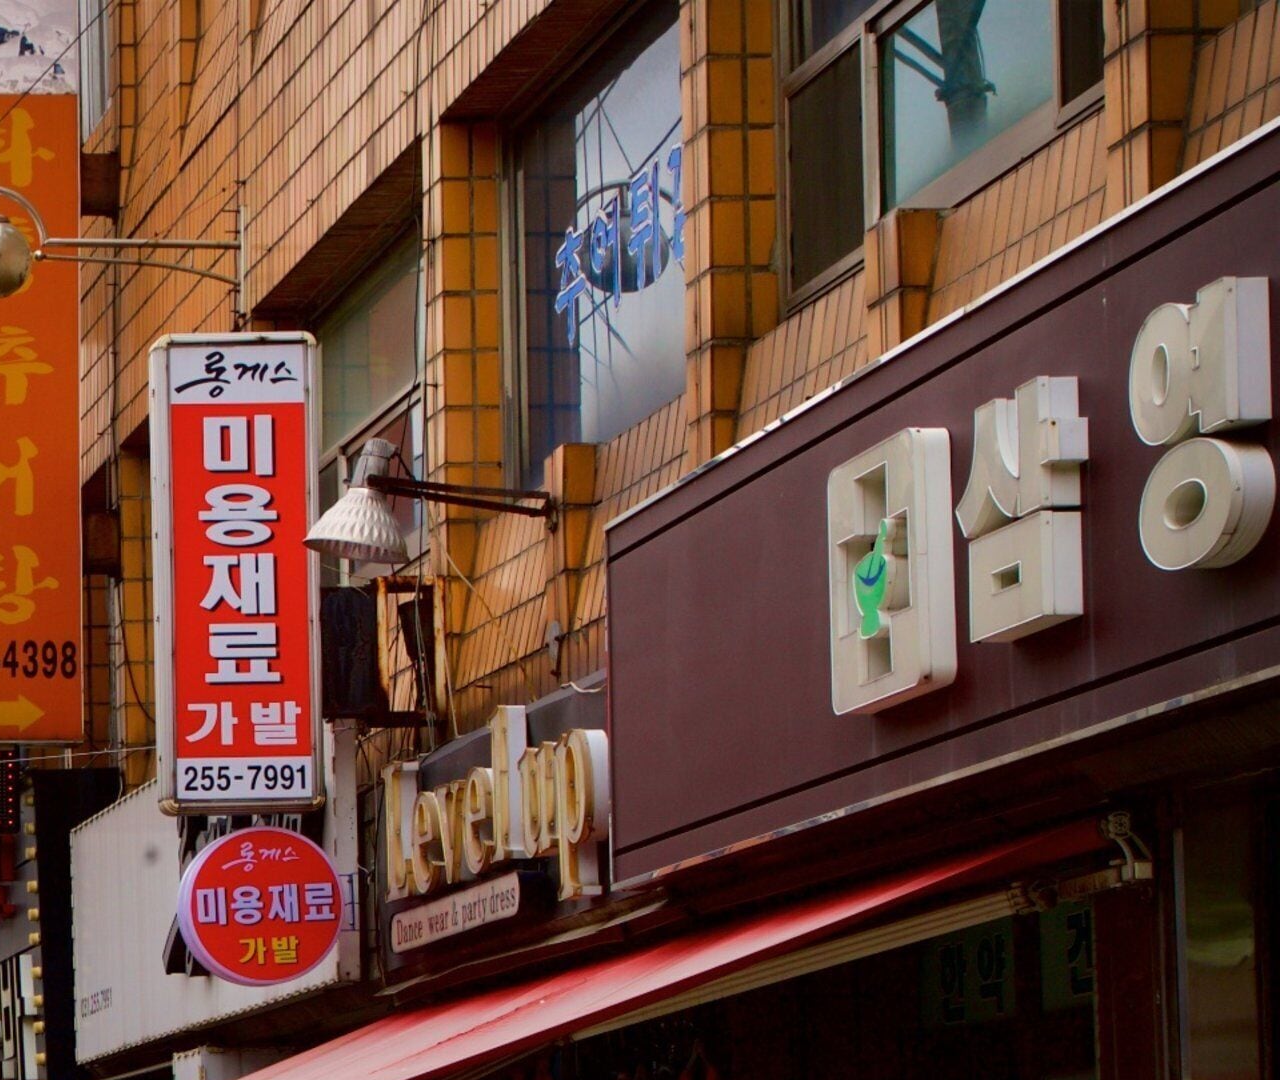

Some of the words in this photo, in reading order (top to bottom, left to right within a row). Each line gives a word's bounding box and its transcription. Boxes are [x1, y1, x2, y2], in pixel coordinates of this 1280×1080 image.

[198, 414, 281, 685] 미용재료
[186, 700, 302, 747] 가발
[183, 763, 309, 793] 255-7991
[196, 882, 336, 927] 미용재료
[396, 918, 424, 946] Dance
[428, 910, 449, 935] wear
[462, 895, 488, 927] party
[490, 885, 517, 914] dress
[238, 934, 299, 966] 가발
